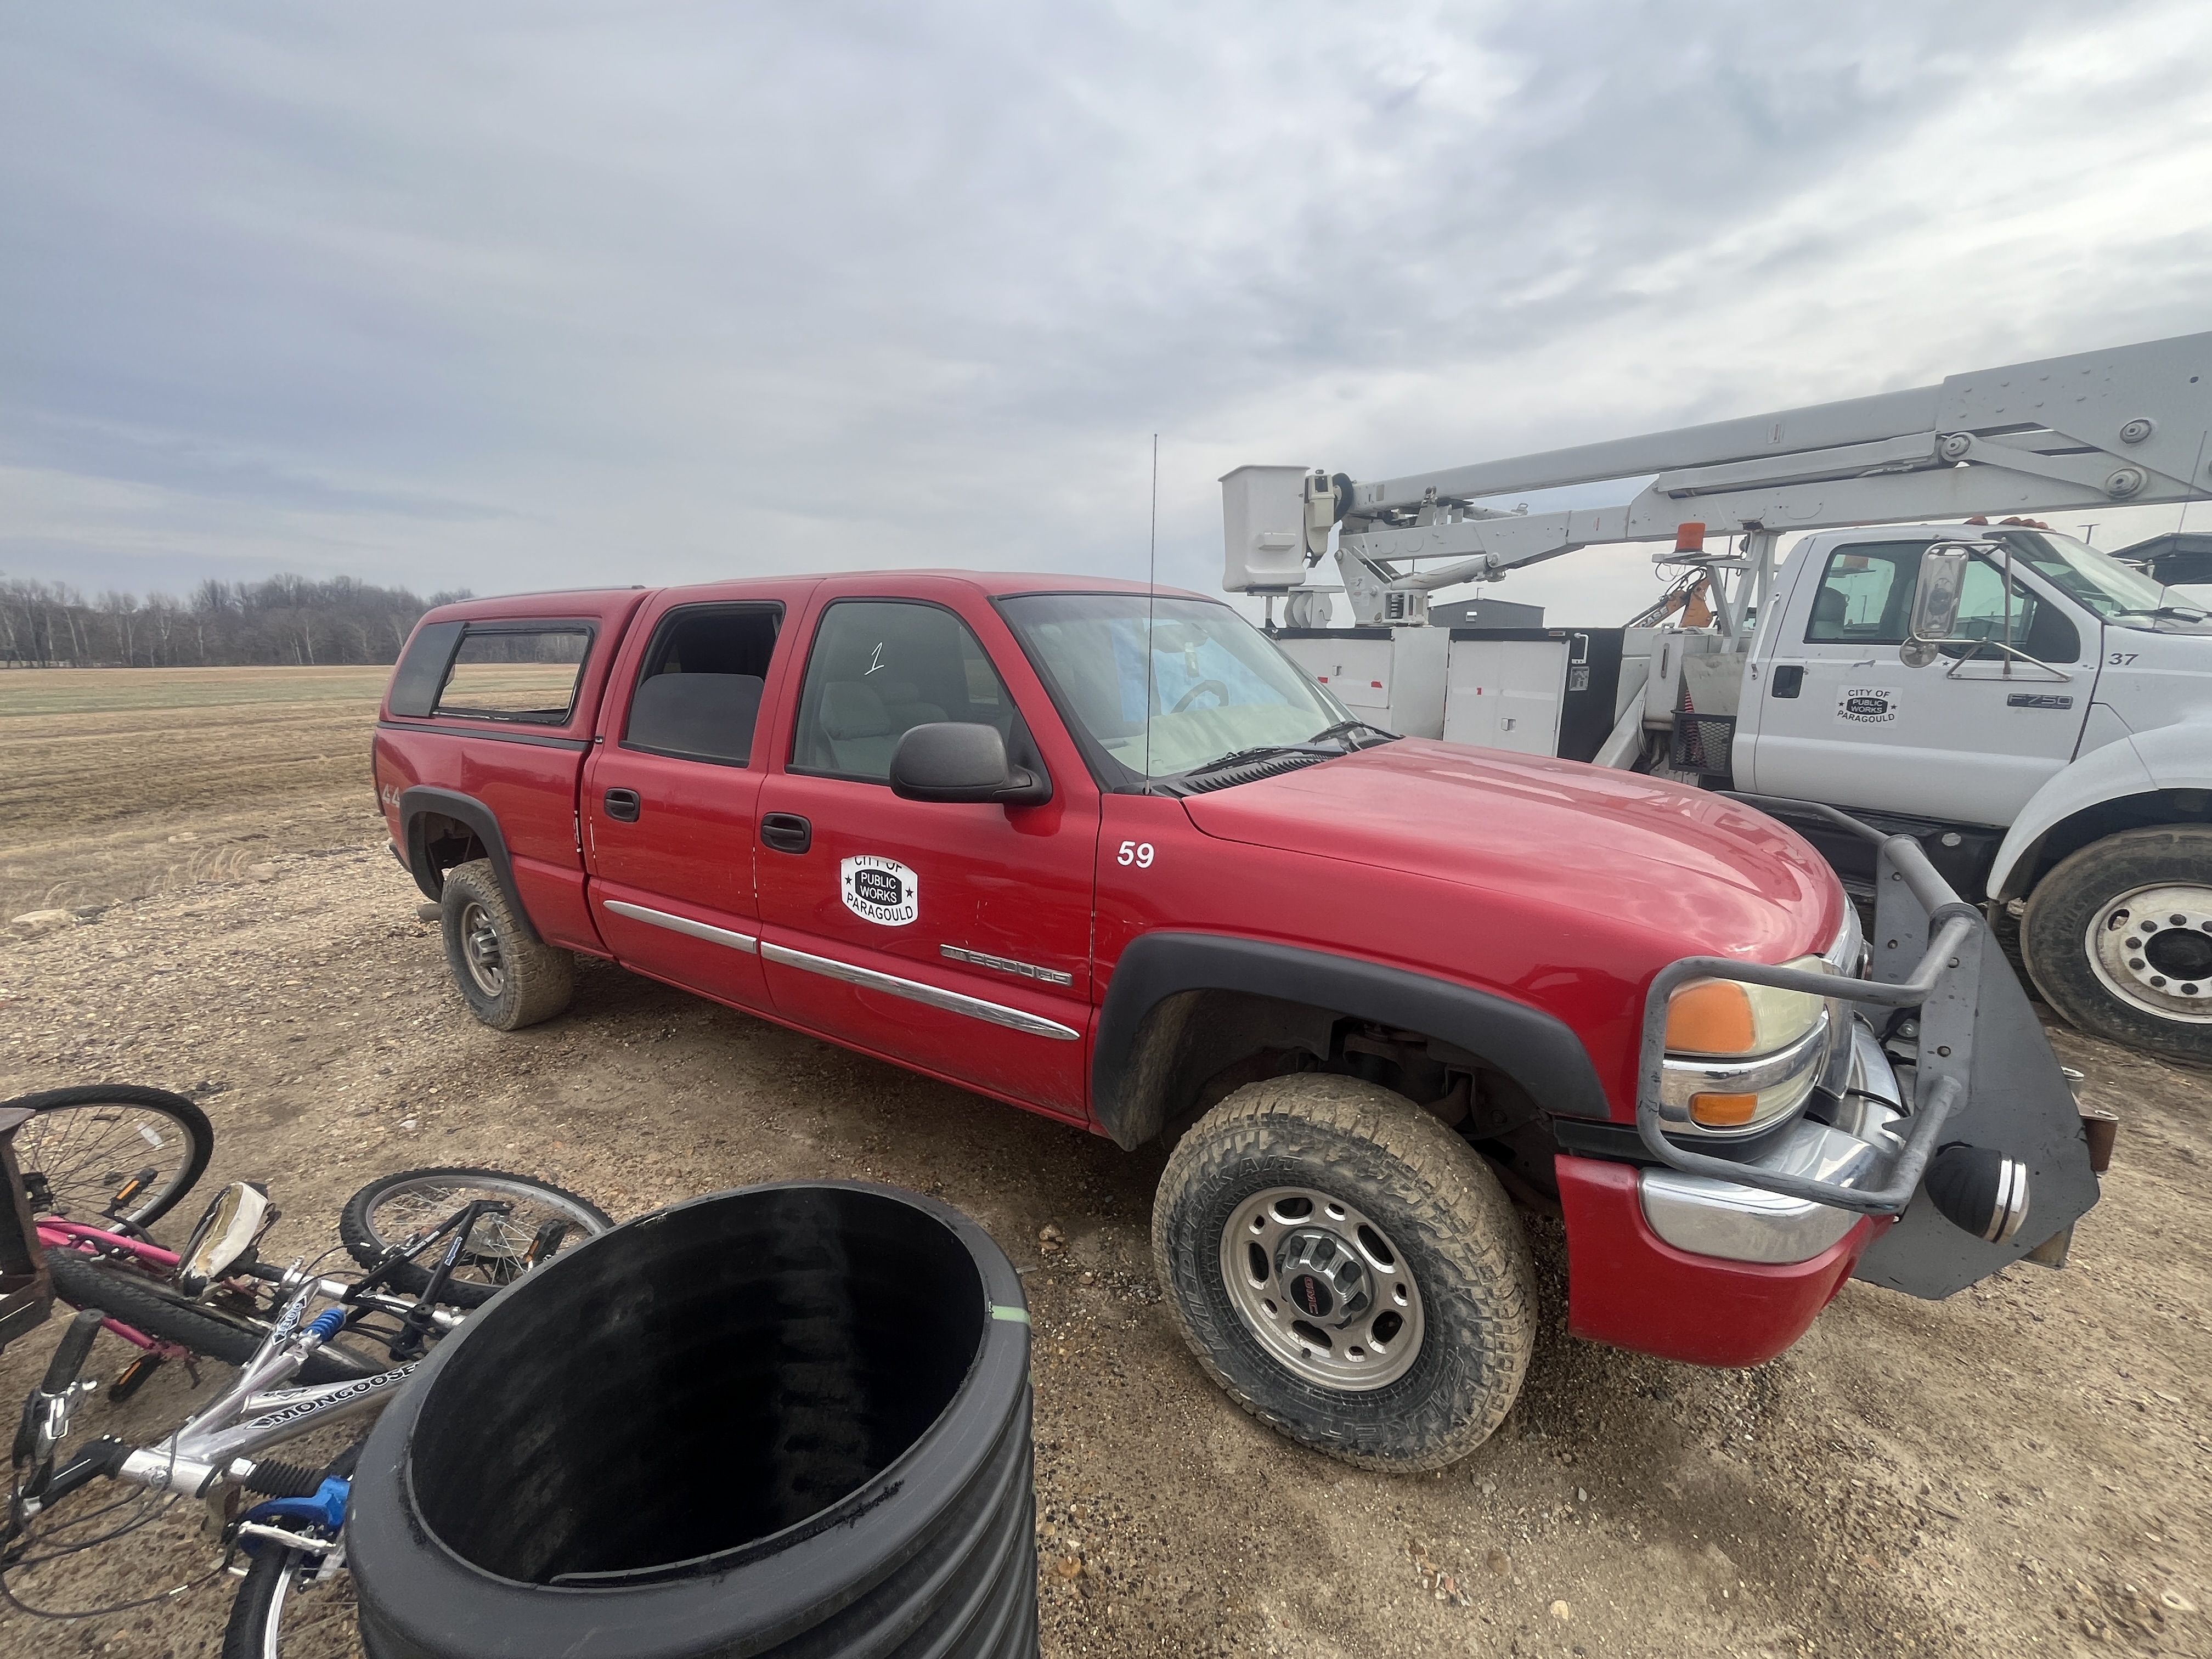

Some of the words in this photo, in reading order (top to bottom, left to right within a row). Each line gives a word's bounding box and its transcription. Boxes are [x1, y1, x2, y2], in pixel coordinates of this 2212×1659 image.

[2108, 653, 2139, 665] 37
[1837, 710, 1895, 723] PARAGOULD
[1117, 840, 1154, 868] 59
[860, 872, 896, 889] PUBLIC
[860, 885, 898, 903] WORKS
[847, 891, 913, 921] PARAGOULD
[1304, 1276, 1319, 1315] GMC
[272, 1358, 421, 1425] MONGOOSE
